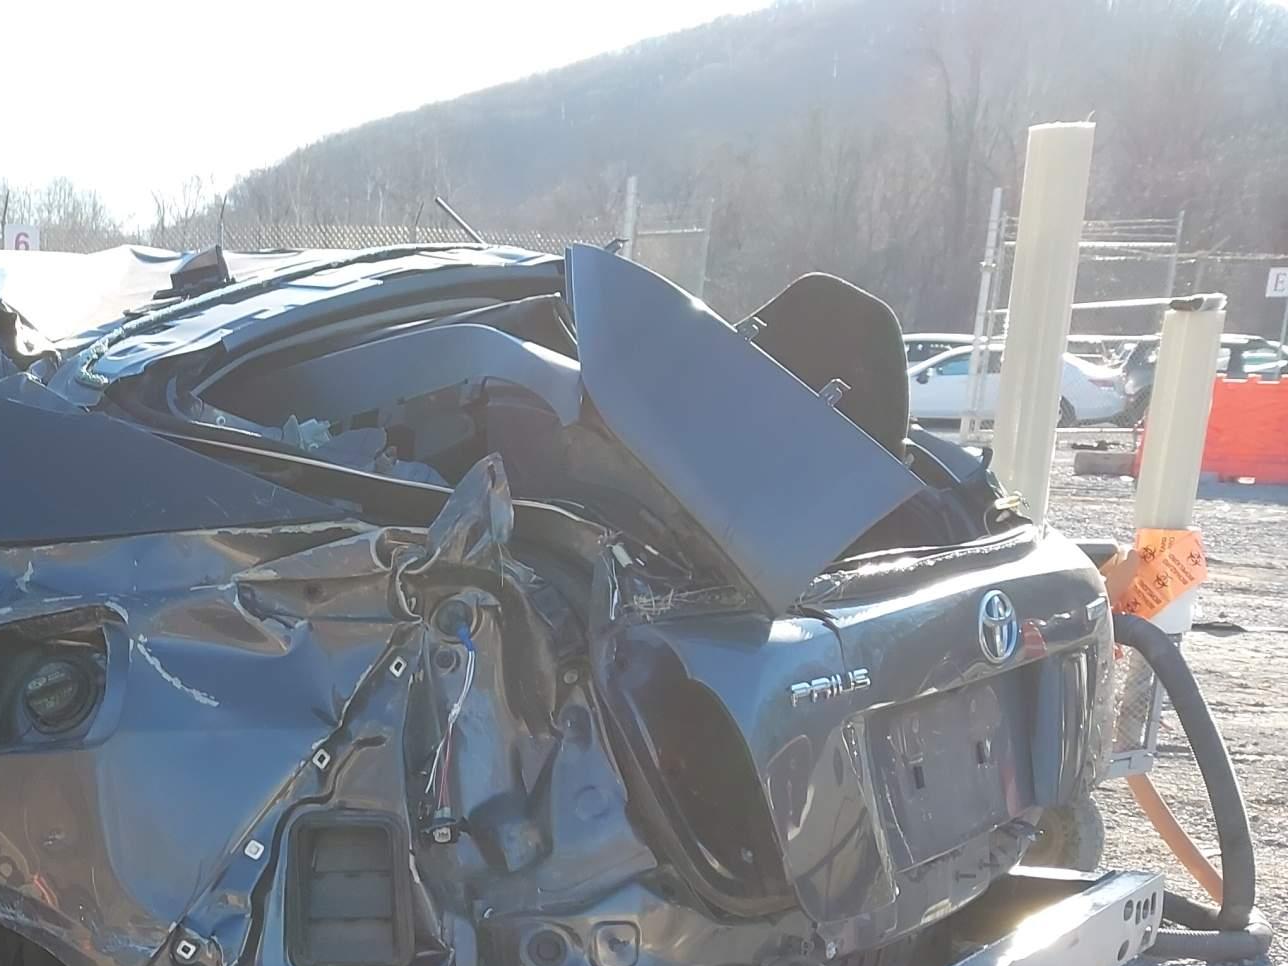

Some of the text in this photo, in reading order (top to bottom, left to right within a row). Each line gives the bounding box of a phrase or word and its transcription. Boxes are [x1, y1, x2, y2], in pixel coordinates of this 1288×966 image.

[14, 231, 30, 250] 6
[1273, 272, 1288, 291] E
[791, 667, 872, 707] PRIUS
